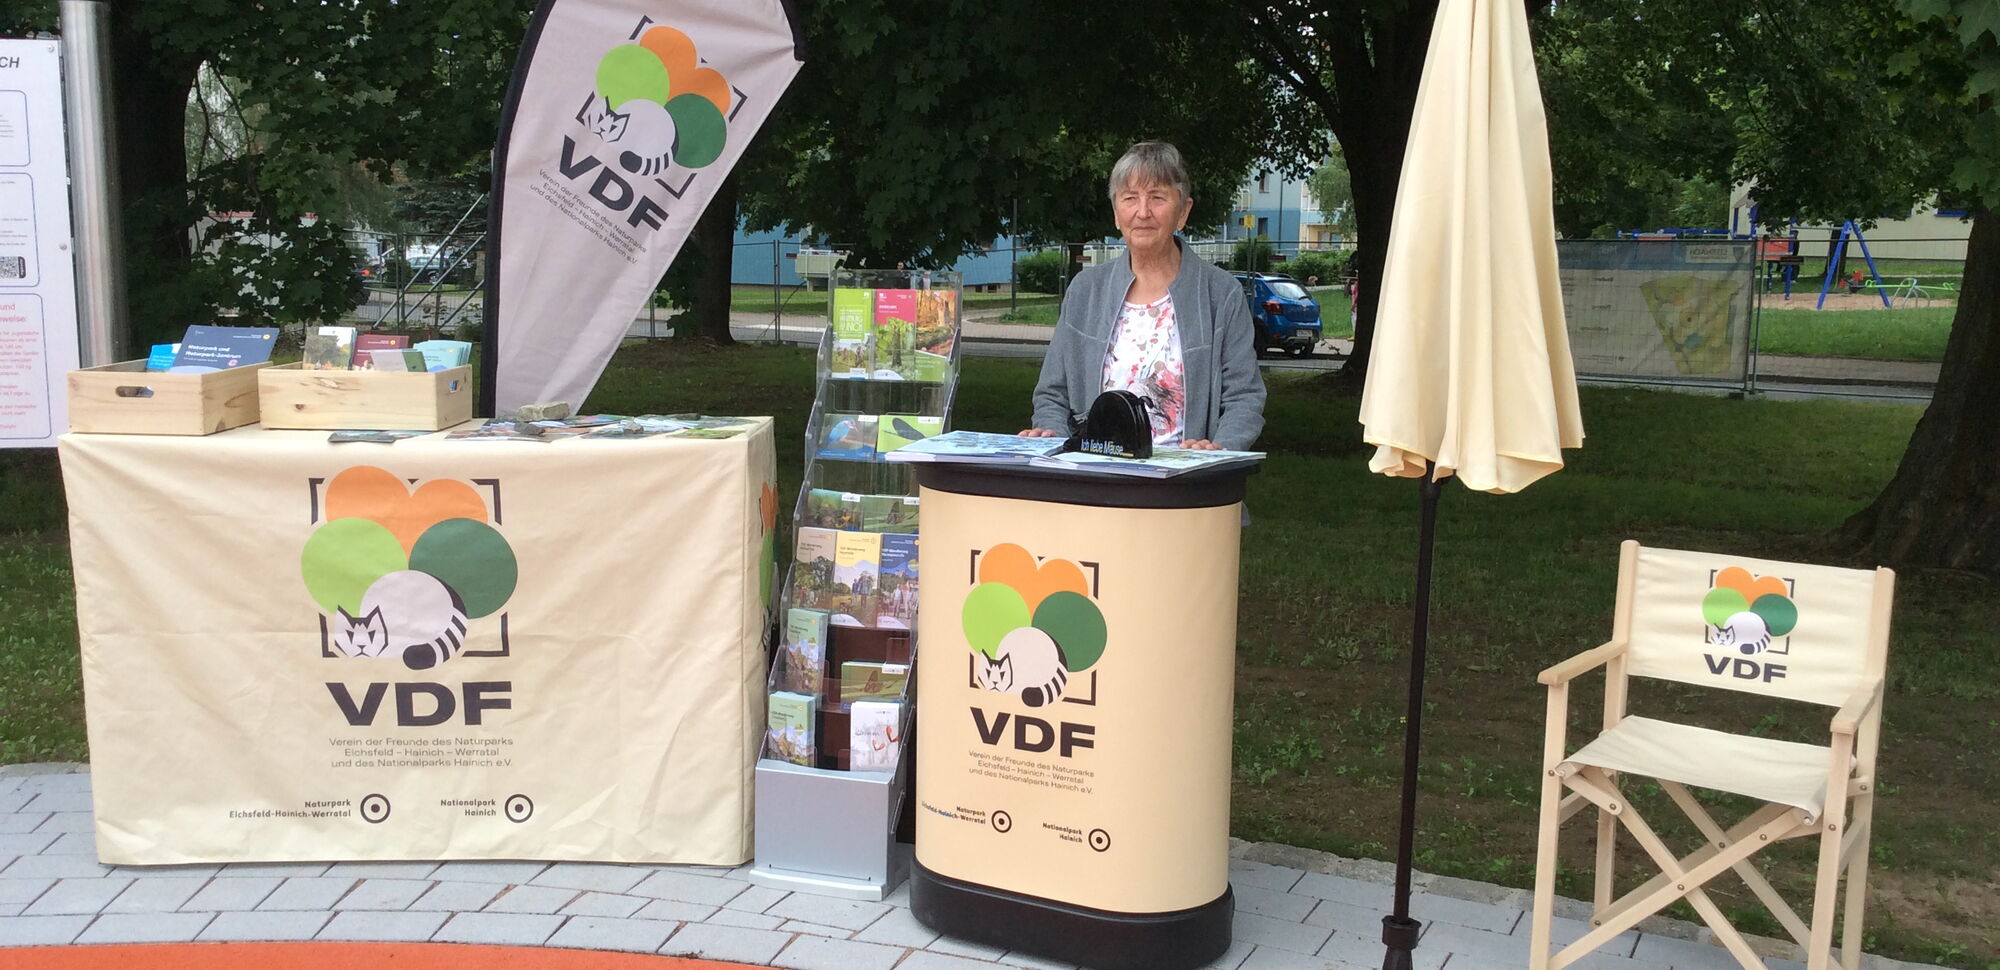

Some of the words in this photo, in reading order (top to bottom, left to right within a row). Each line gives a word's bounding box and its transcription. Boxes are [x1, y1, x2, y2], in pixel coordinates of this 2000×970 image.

[559, 134, 670, 232] VDF
[530, 184, 545, 200] und
[545, 194, 558, 208] des
[558, 203, 603, 240] Nationalparks
[603, 237, 627, 256] Hainich
[539, 169, 560, 188] Verein
[560, 184, 574, 198] der
[574, 195, 600, 217] Freunde
[600, 214, 613, 229] des
[613, 225, 647, 253] Naturparks
[542, 183, 575, 209] Eichsfeld
[579, 209, 604, 231] Hainich
[608, 231, 636, 252] Werratal
[1703, 653, 1787, 683] VDF
[325, 681, 512, 726] VDF
[970, 706, 1095, 758] VDF
[329, 737, 363, 746] Verein
[365, 737, 382, 746] der
[386, 737, 429, 746] Freunde
[432, 737, 451, 746] des
[455, 737, 514, 748] Naturparks
[344, 748, 394, 756] Eichsfeld
[404, 748, 444, 756] Hainich
[456, 748, 500, 756] Werratal
[331, 759, 352, 767] und
[355, 759, 375, 767] des
[378, 758, 451, 768] Nationalparks
[454, 758, 493, 767] Hainich
[496, 758, 513, 767] e.V.
[969, 750, 991, 759] Verein
[991, 754, 1003, 762] der
[1005, 756, 1035, 769] Freunde
[1037, 761, 1050, 771] des
[1052, 764, 1095, 778] Naturparks
[978, 760, 1010, 772] Eichsfeld
[1017, 767, 1045, 778] Hainich
[1052, 773, 1084, 784] Werratal
[969, 767, 984, 776] und
[984, 769, 997, 778] des
[998, 772, 1049, 787] Nationalparks
[1051, 781, 1079, 792] Hainich
[304, 799, 351, 808] Naturpark
[440, 799, 496, 808] Nationalpark
[464, 808, 497, 817] Hainich
[956, 806, 986, 817] Naturpark
[229, 809, 351, 819] Eichsfeld-Hainich-Werratal
[1042, 822, 1083, 835] Nationalpark
[1059, 834, 1083, 843] Hainich
